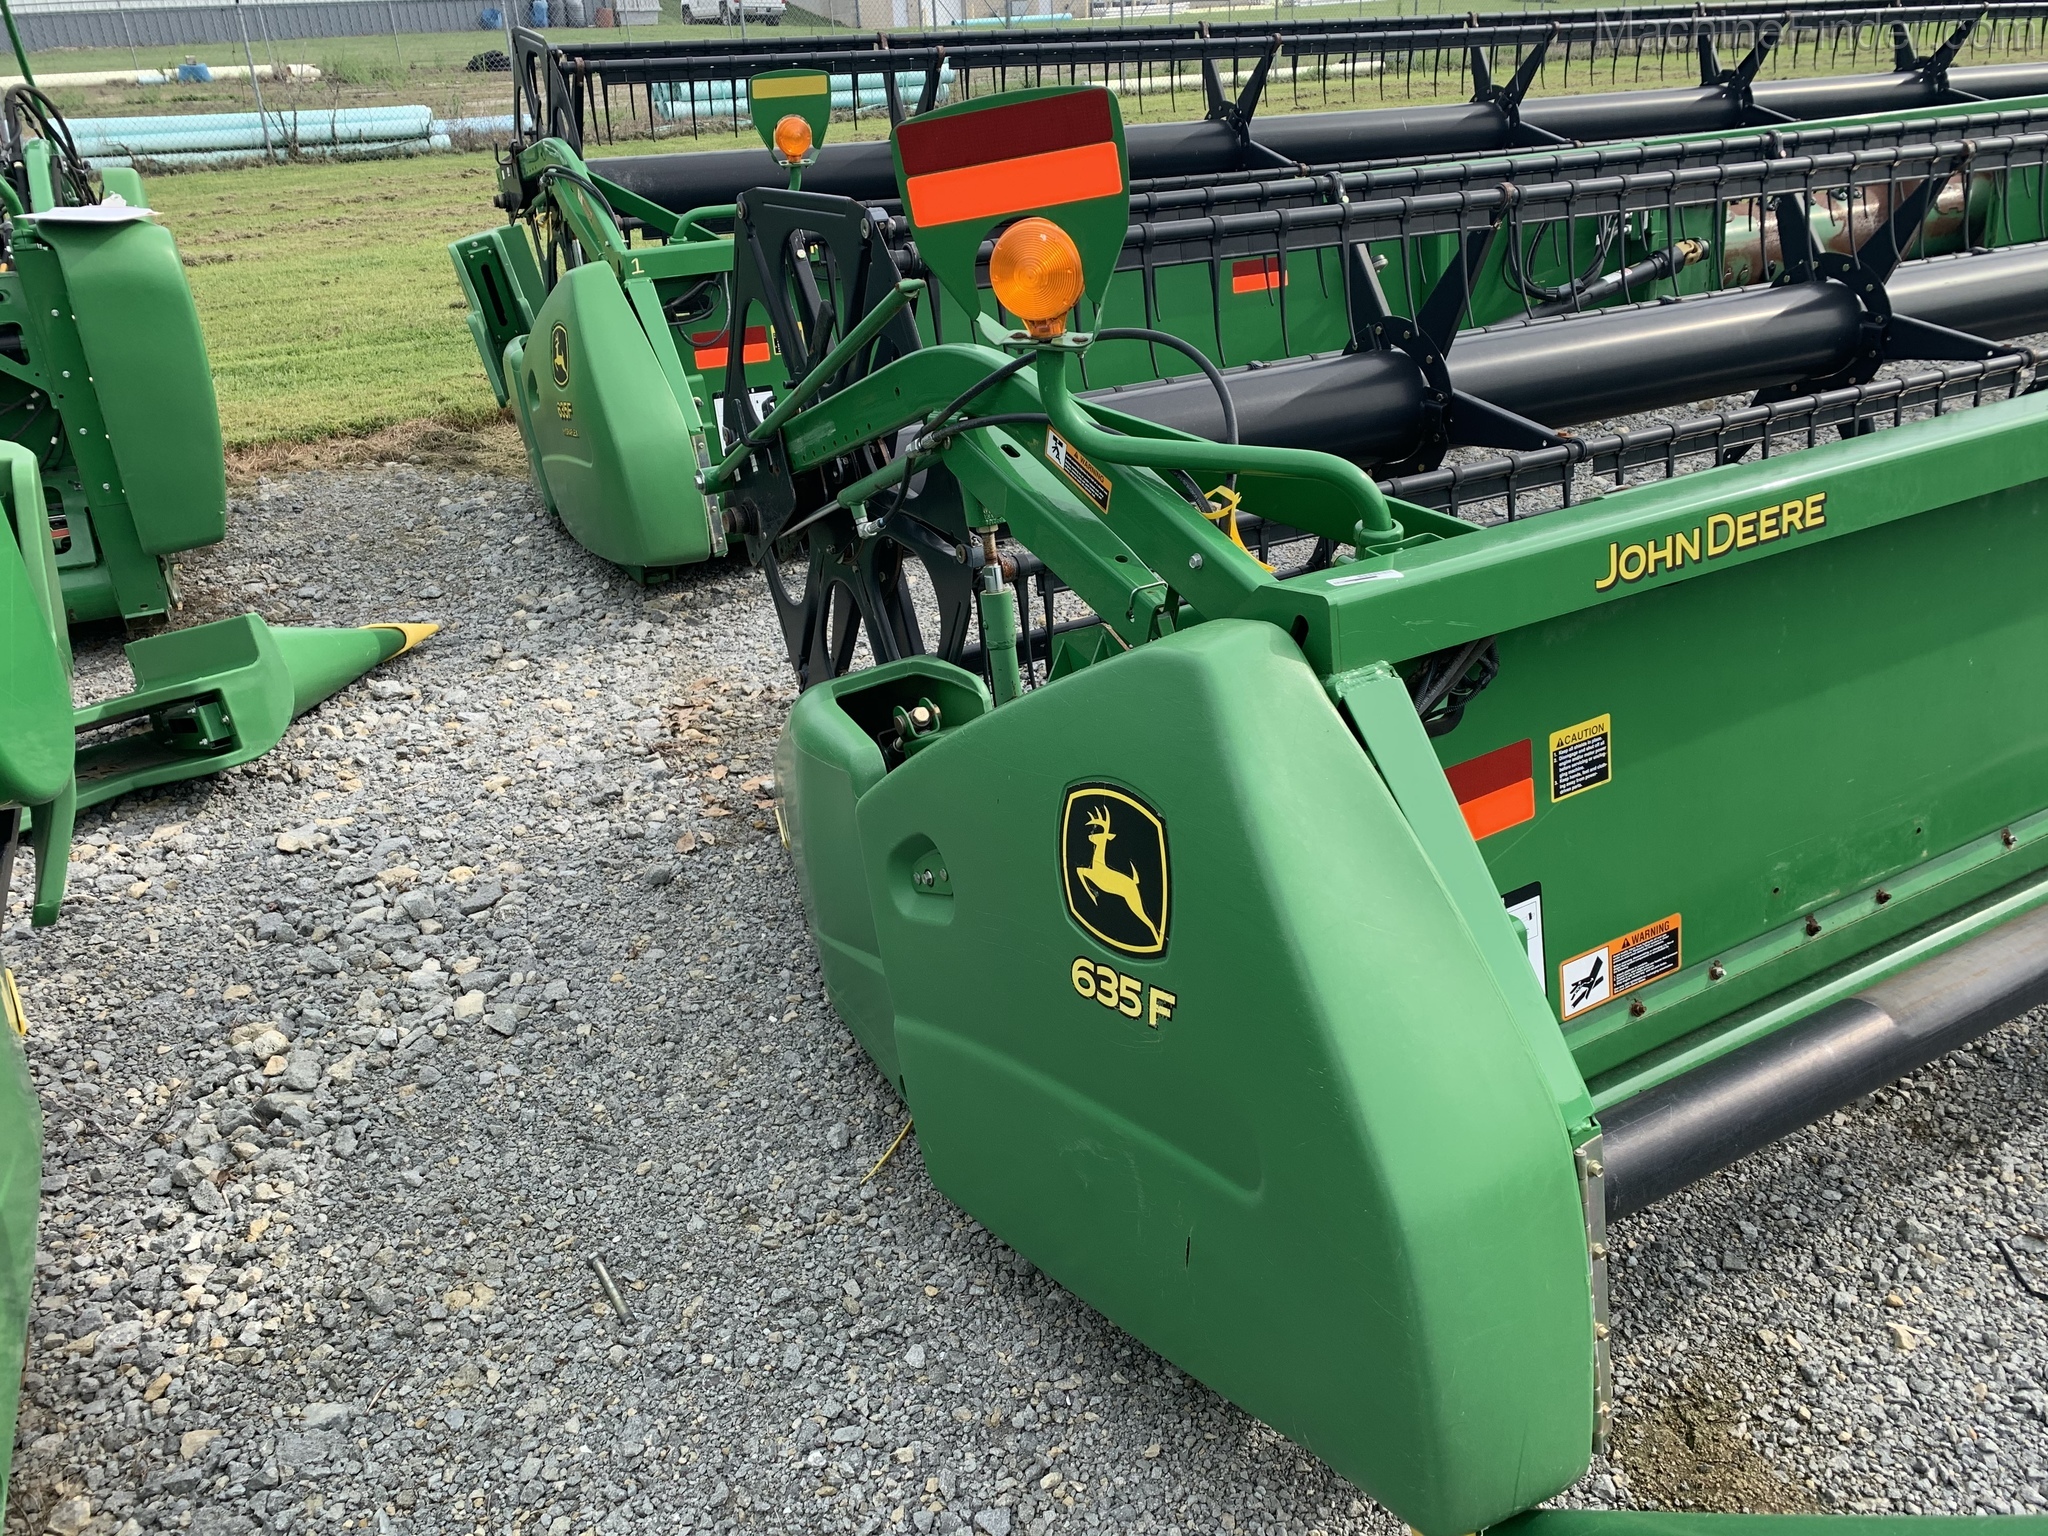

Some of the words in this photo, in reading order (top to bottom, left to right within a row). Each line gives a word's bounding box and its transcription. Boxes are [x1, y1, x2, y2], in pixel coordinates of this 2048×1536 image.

[630, 257, 645, 275] 1
[1079, 457, 1105, 483] WARNING
[1595, 526, 1702, 592] JOHN
[1706, 491, 1828, 559] DEERE
[1564, 723, 1605, 745] CAUTION
[1631, 920, 1670, 945] WARNING
[1070, 955, 1178, 1030] 635F
